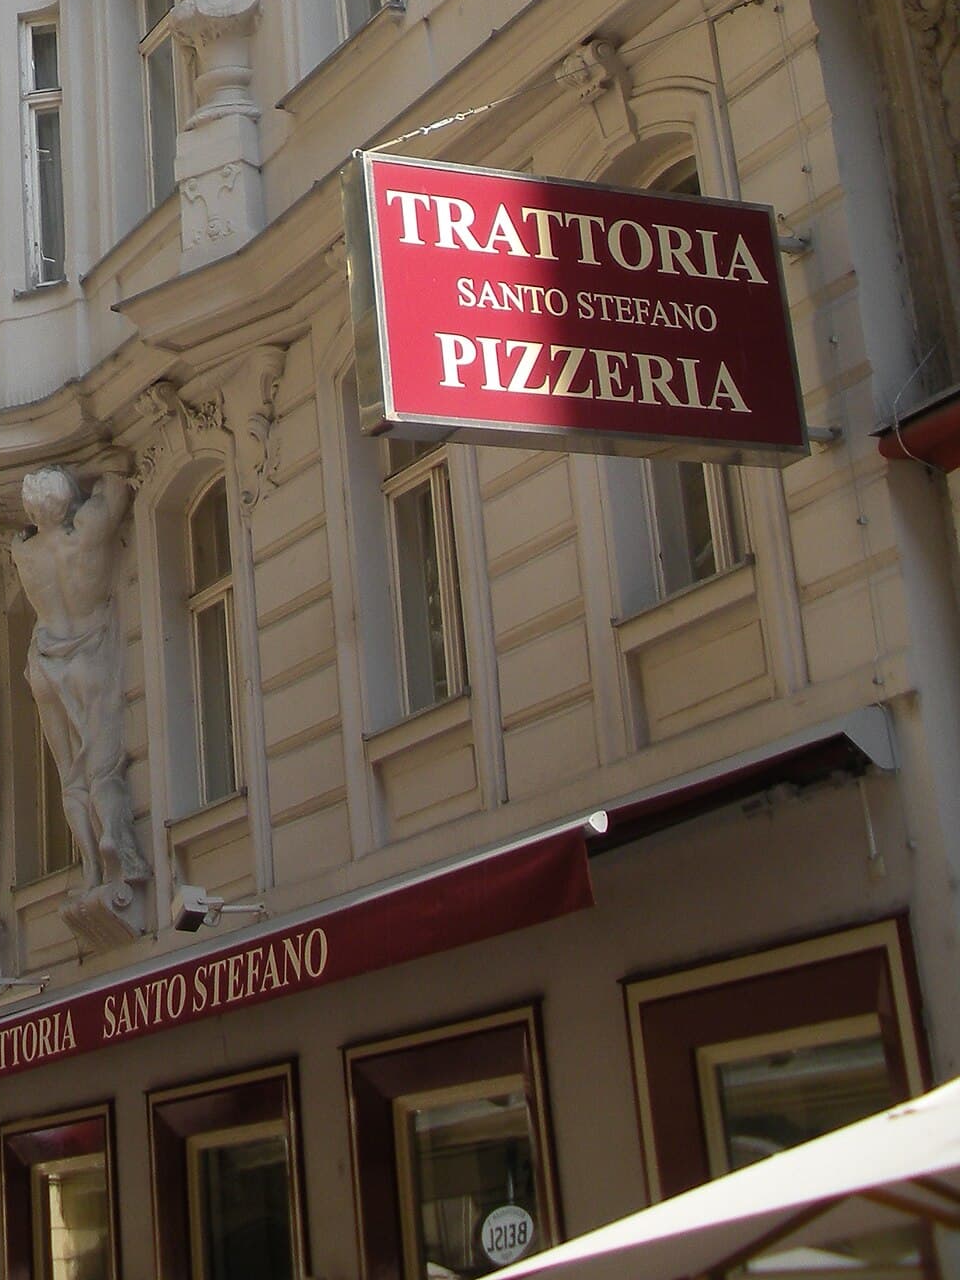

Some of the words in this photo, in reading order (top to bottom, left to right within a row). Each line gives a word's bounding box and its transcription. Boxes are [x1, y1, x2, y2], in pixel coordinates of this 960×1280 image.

[385, 188, 769, 285] TRATTORIA
[456, 276, 570, 317] SANTO
[577, 290, 719, 333] STEFANO
[434, 332, 752, 414] PIZZERIA
[102, 972, 187, 1039] SANTO
[191, 927, 329, 1013] STEFANO
